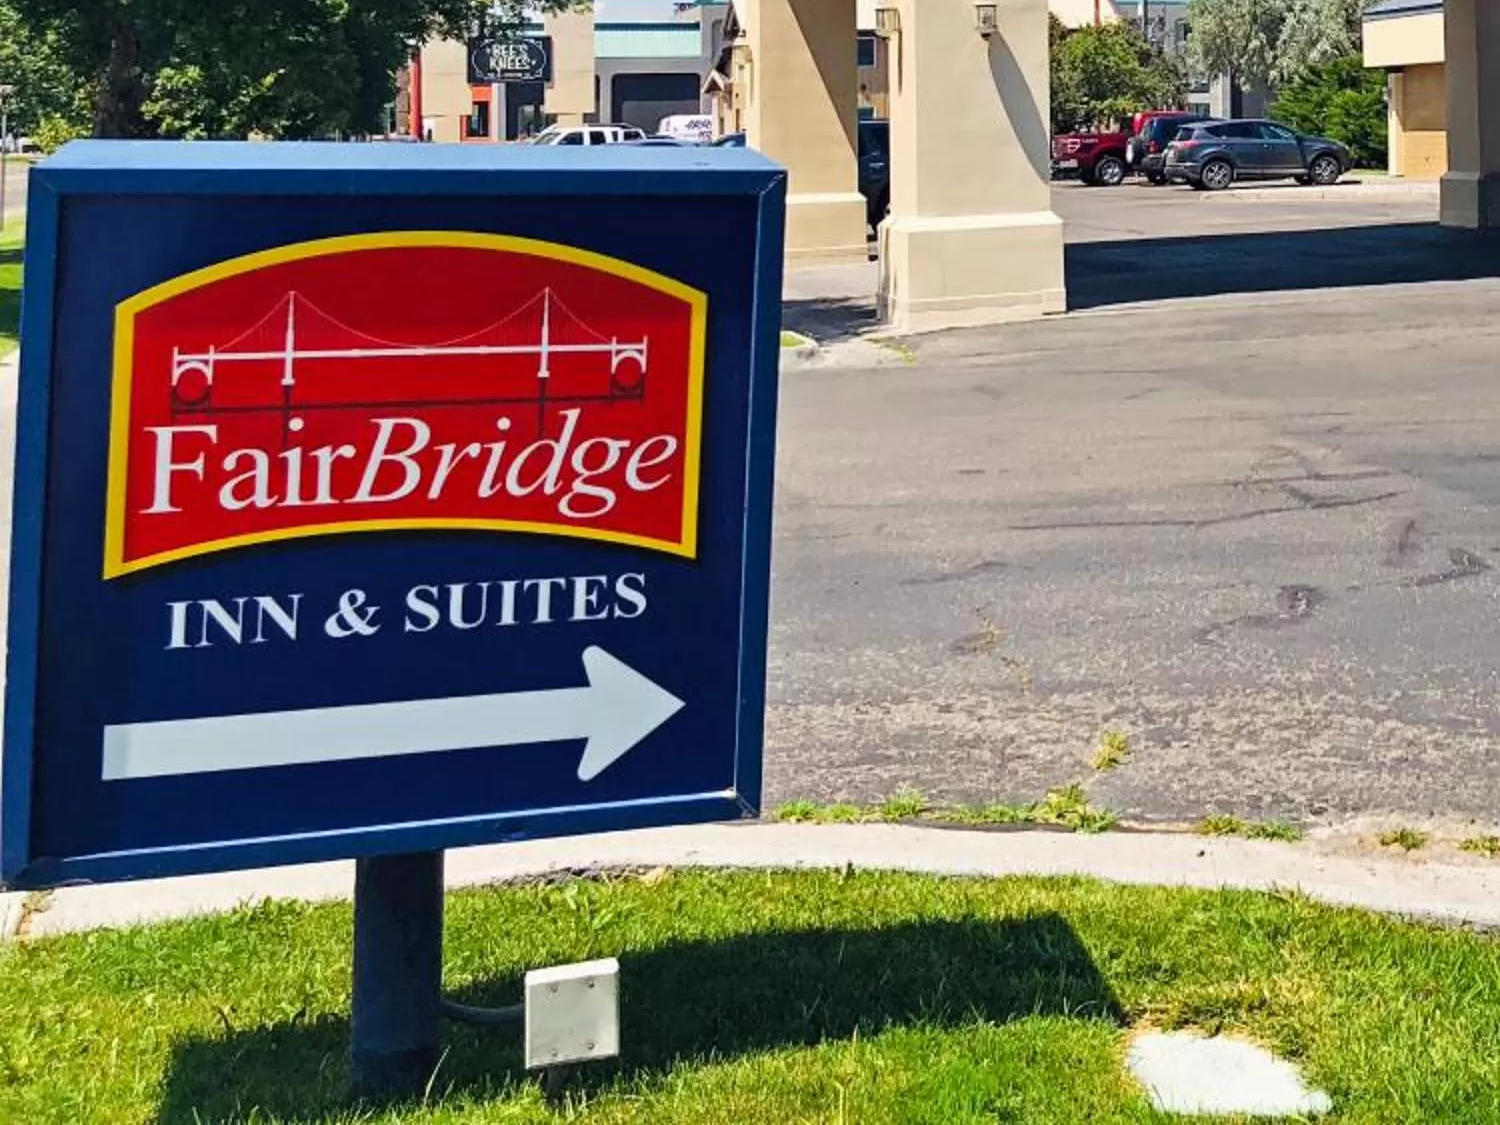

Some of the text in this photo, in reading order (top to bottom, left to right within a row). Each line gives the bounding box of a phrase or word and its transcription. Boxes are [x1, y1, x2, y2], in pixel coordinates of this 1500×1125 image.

[489, 56, 531, 71] KNEES
[138, 408, 678, 519] FairBridge
[164, 572, 648, 650] INN & SUITES
